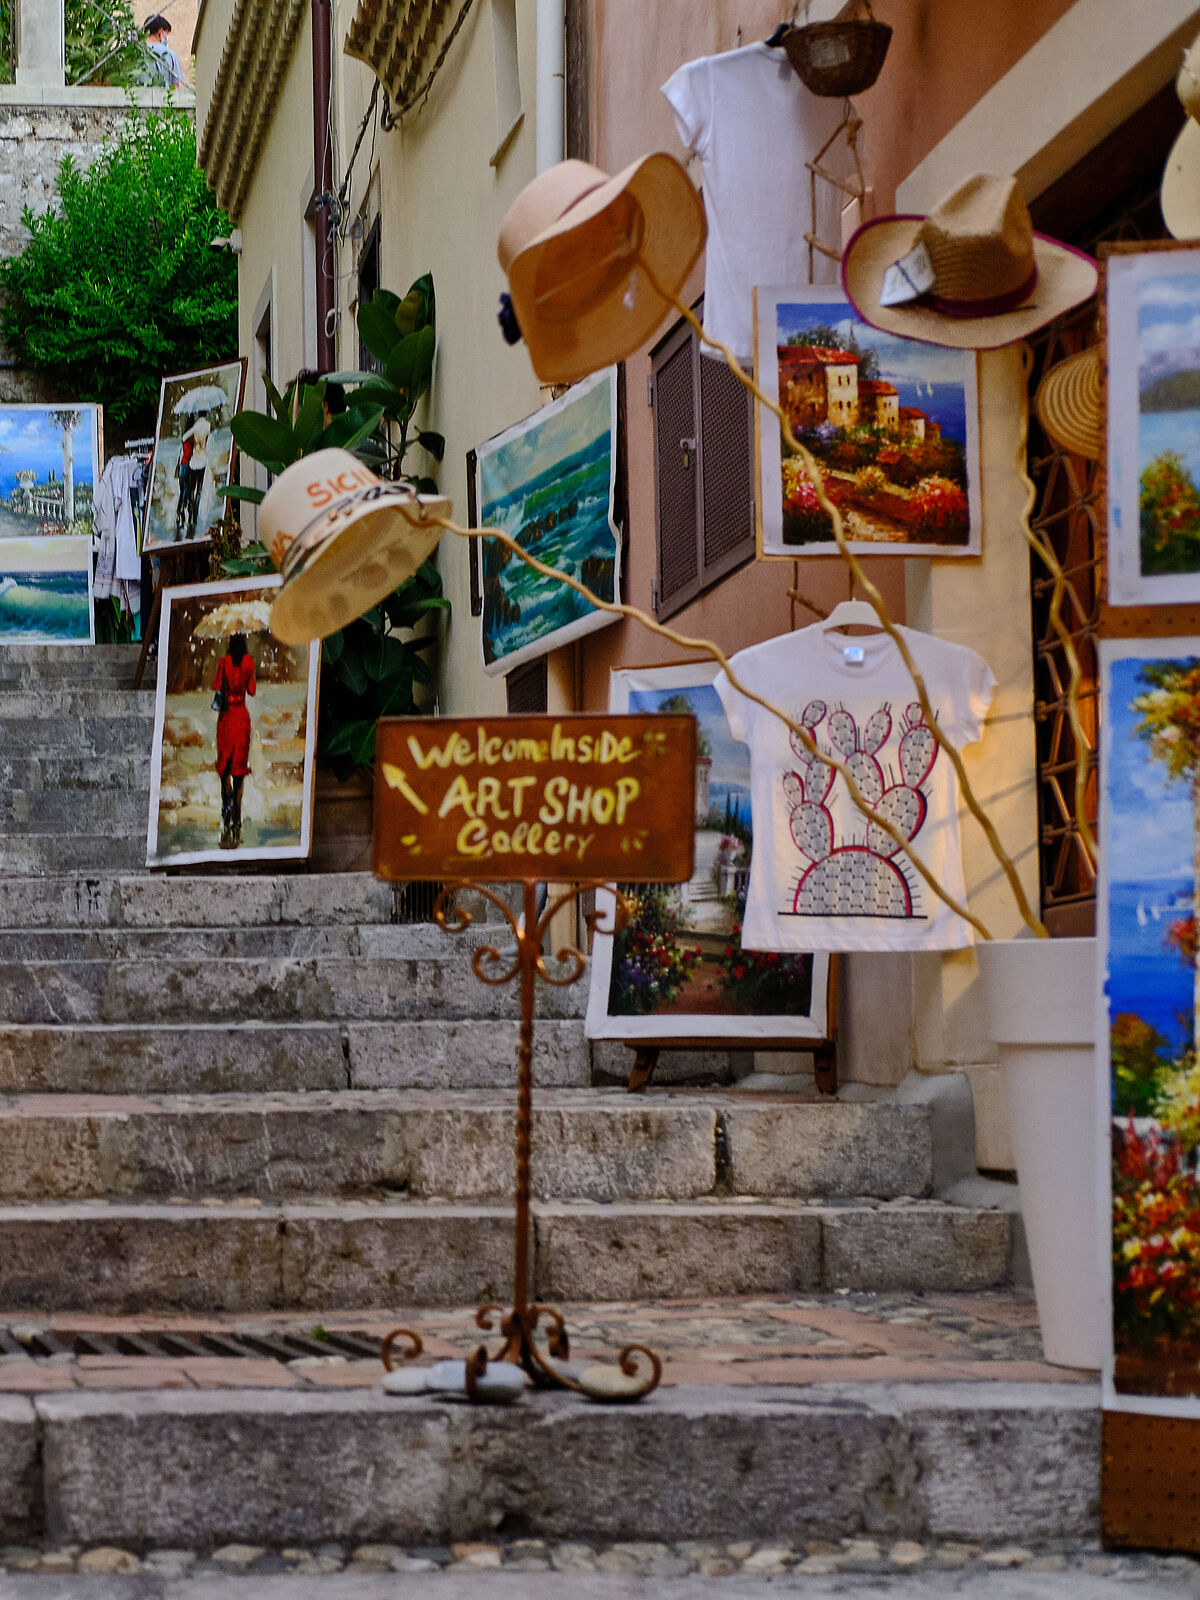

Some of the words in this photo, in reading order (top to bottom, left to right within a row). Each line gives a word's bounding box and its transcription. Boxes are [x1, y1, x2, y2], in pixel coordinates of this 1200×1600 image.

[407, 725, 549, 770] Welcome
[437, 774, 538, 819] ART
[538, 776, 641, 825] SHOP
[456, 818, 595, 861] Gallery
